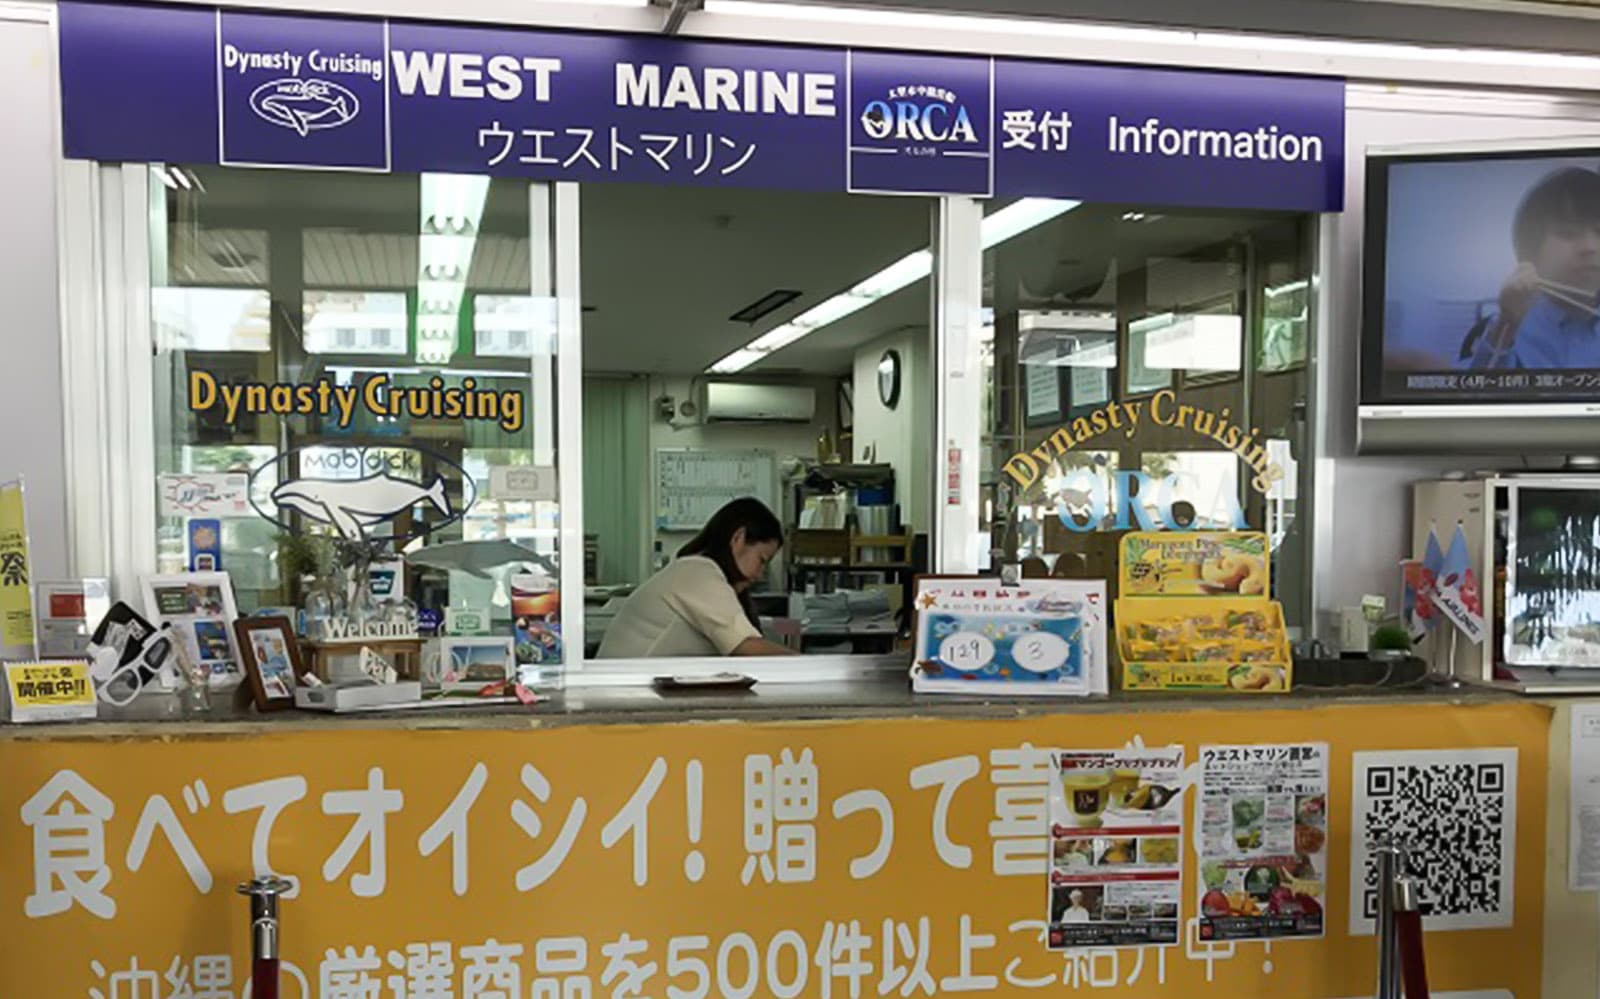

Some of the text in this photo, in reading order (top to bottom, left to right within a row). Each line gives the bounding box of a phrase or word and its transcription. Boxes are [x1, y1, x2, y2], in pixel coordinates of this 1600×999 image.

[224, 44, 383, 81] Dynasty Cruising
[391, 50, 836, 117] WEST MARINE
[861, 100, 978, 143] ORCA
[1002, 111, 1073, 151] 受付
[1109, 117, 1323, 162] Information
[477, 121, 757, 176] ウエストマリン
[188, 369, 524, 432] Dynasty Cruising
[1002, 400, 1143, 491] Dynasty
[1150, 390, 1285, 493] Cruising
[1058, 468, 1250, 533] ORCA
[322, 615, 419, 641] Welcome
[949, 640, 980, 662] 129
[1027, 641, 1045, 661] 3
